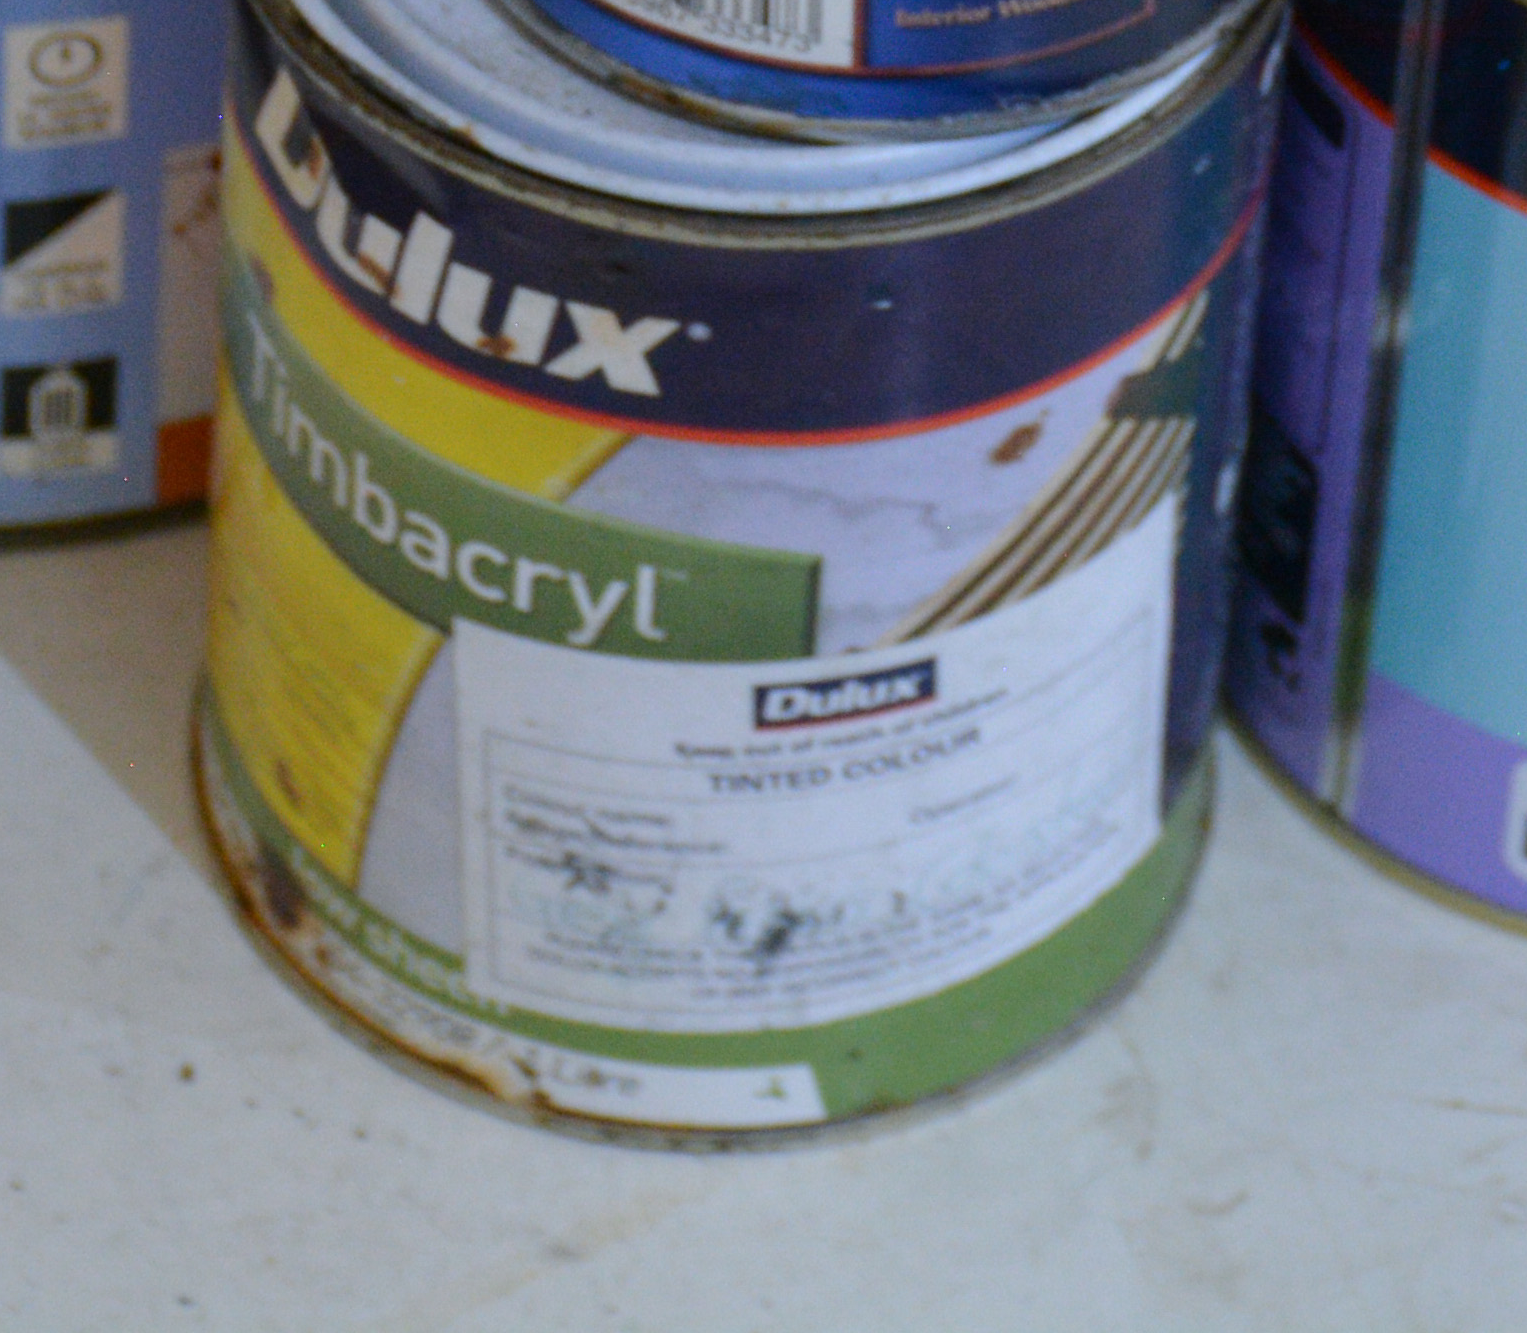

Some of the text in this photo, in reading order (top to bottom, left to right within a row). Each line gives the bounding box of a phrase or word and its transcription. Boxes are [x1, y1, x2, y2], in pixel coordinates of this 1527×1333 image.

[253, 64, 682, 398] Dulux
[246, 309, 669, 649] Timbacryl
[708, 728, 981, 794] TINTED COLOUR
[762, 670, 924, 722] Dulux
